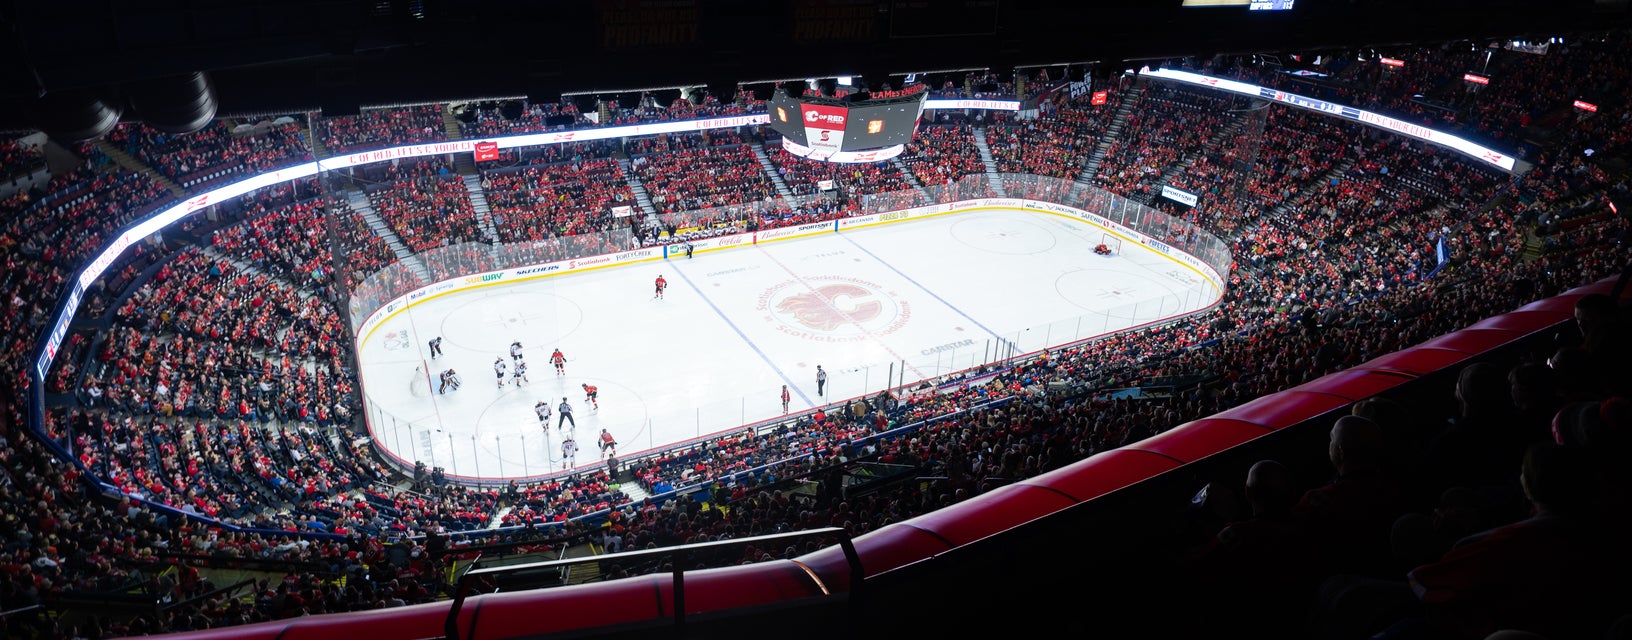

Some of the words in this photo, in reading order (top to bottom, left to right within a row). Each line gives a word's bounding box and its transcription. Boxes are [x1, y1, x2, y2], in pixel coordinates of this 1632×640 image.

[827, 114, 845, 122] RED
[1080, 211, 1104, 224] SAFEWAY
[798, 221, 833, 232] SPORTSNET
[1149, 239, 1170, 254] POPEYES
[577, 256, 611, 267] Scotiabank
[516, 264, 560, 276] SKECHERS
[465, 271, 505, 285] SUBWAY
[411, 289, 427, 300] Mobil
[920, 338, 975, 356] CARSTAR
